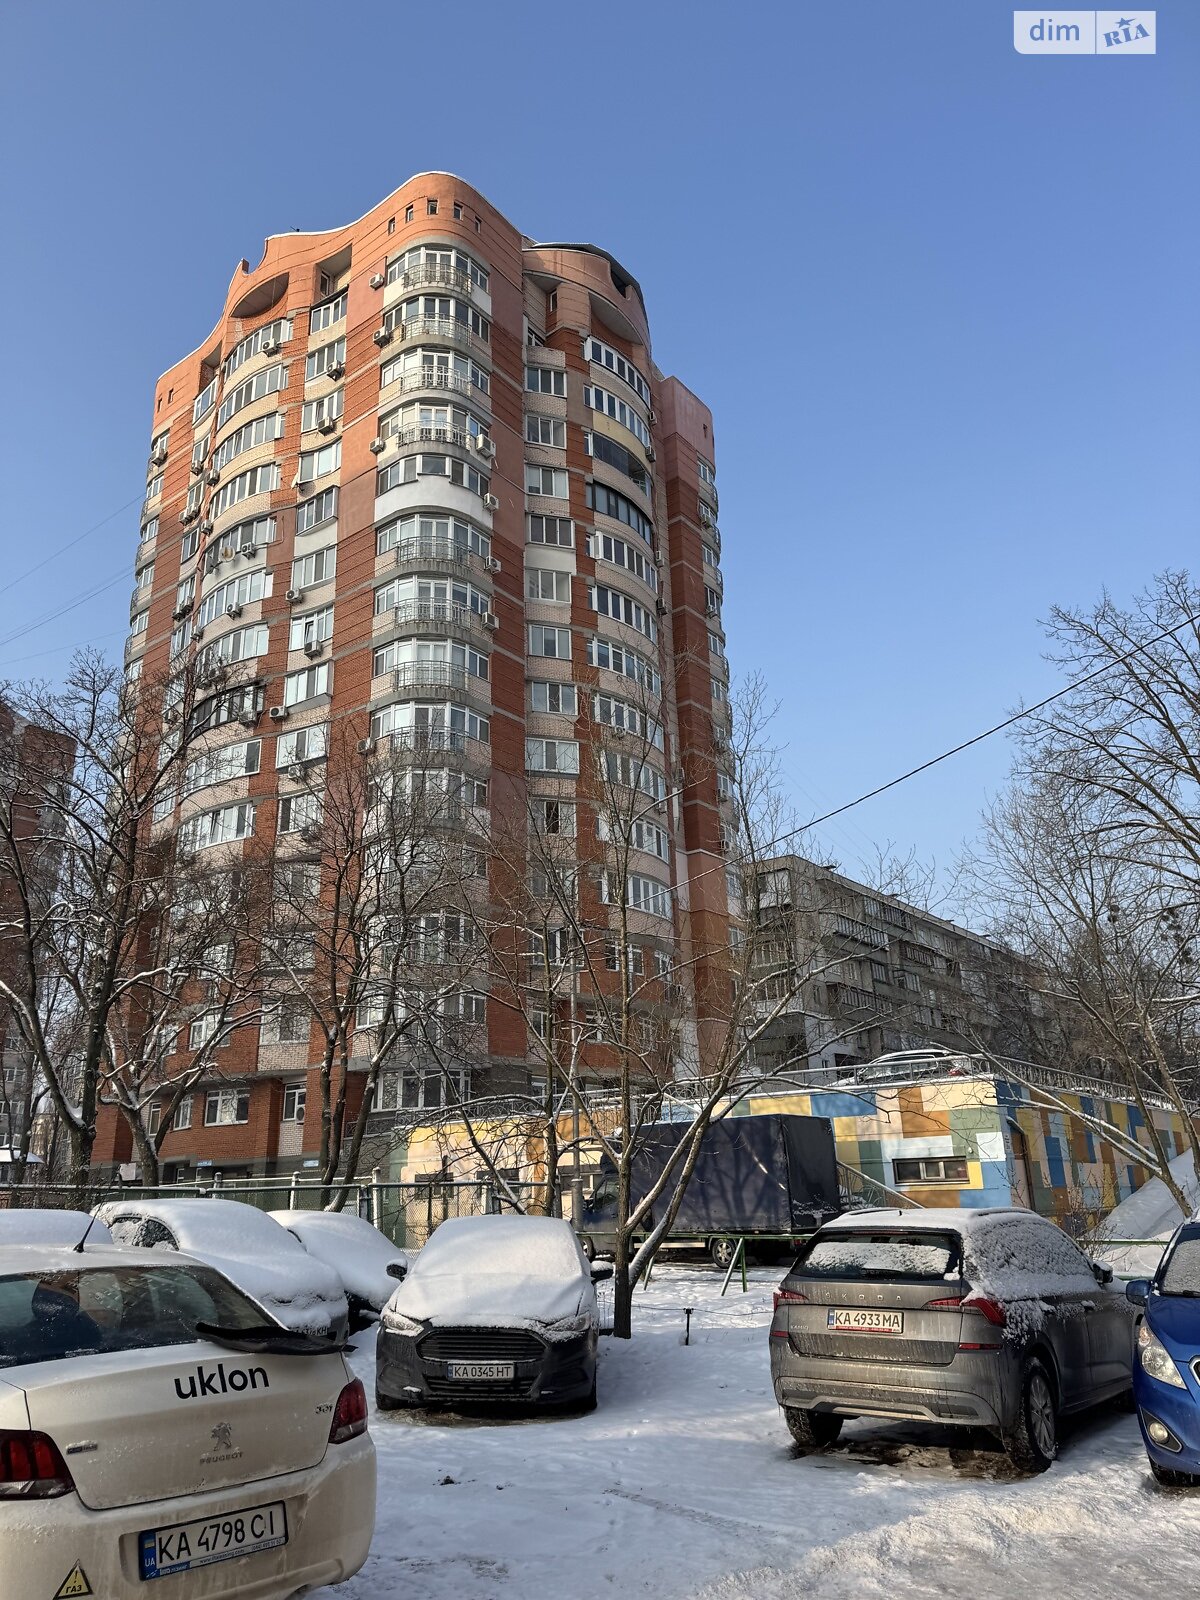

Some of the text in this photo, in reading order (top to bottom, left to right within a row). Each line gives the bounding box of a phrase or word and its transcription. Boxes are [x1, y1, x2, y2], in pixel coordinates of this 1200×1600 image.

[835, 1312, 900, 1328] KA 4933 MA
[454, 1366, 511, 1378] KA 0345 HT
[174, 1363, 270, 1399] uklon
[200, 1451, 243, 1464] PEUGEOT
[158, 1531, 192, 1564] KA
[197, 1518, 246, 1552] 4798
[251, 1511, 275, 1539] CI
[144, 1557, 156, 1567] UA
[65, 1584, 82, 1594] ГАЗ
